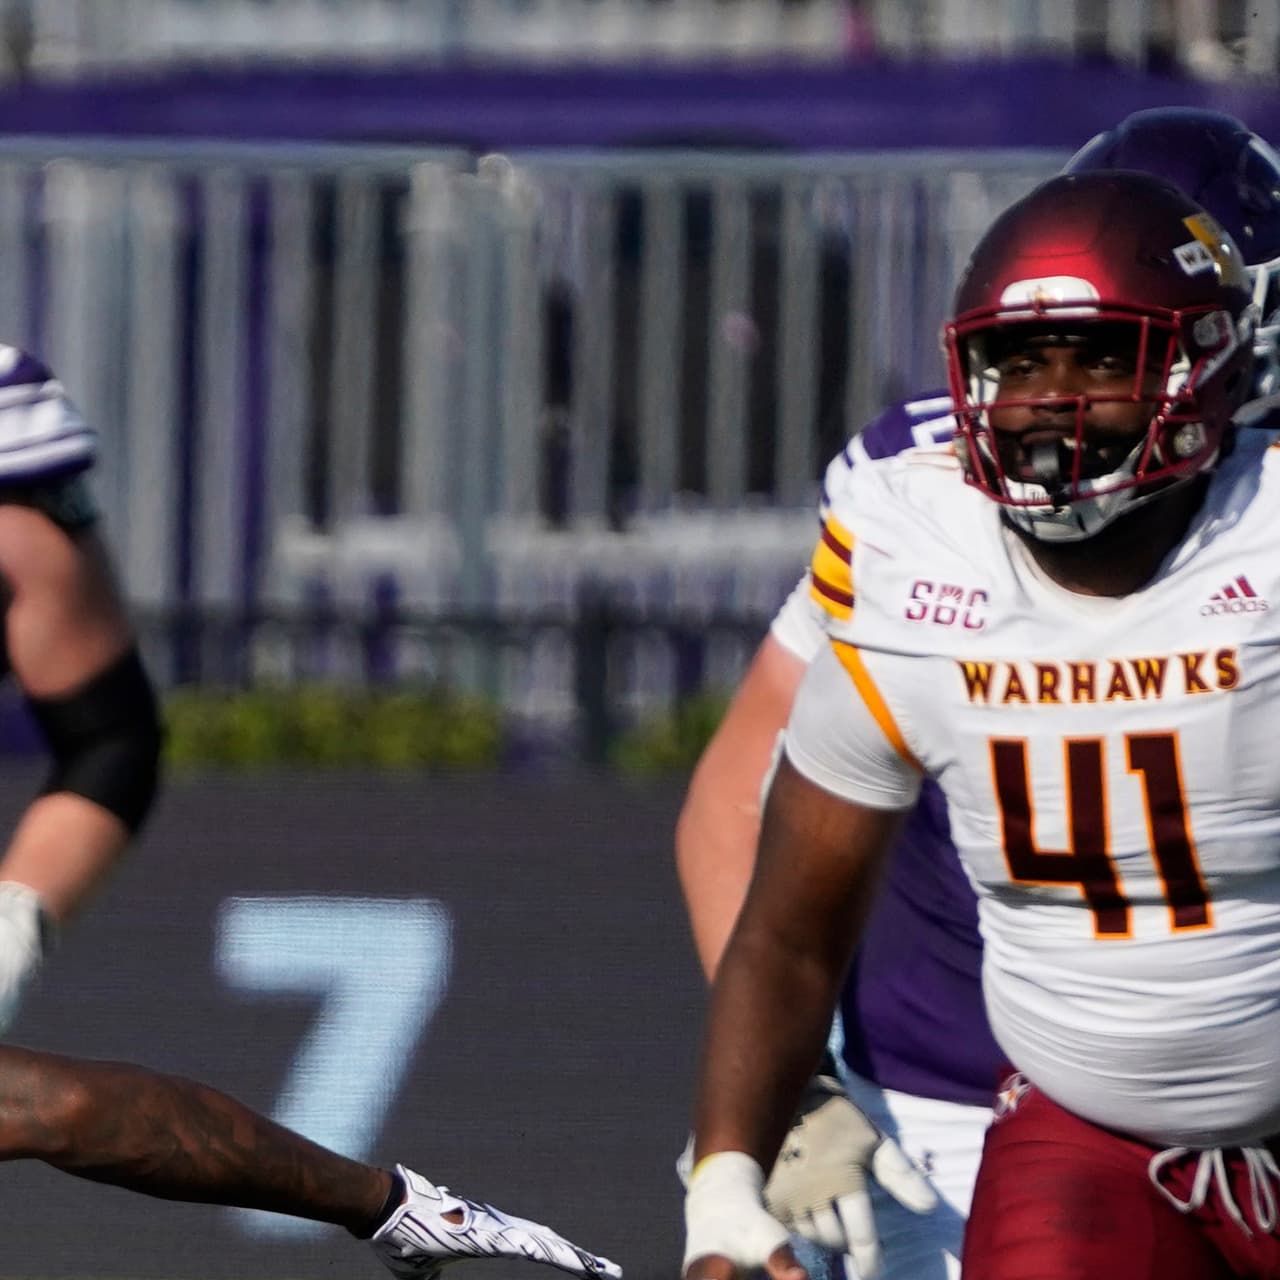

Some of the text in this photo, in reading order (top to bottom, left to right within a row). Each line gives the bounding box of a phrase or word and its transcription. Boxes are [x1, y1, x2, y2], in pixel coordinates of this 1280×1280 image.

[905, 579, 991, 632] SBC
[1200, 599, 1270, 618] adidas
[954, 646, 1241, 705] WARHAWKS
[987, 729, 1216, 941] 41
[213, 895, 453, 1245] 7
